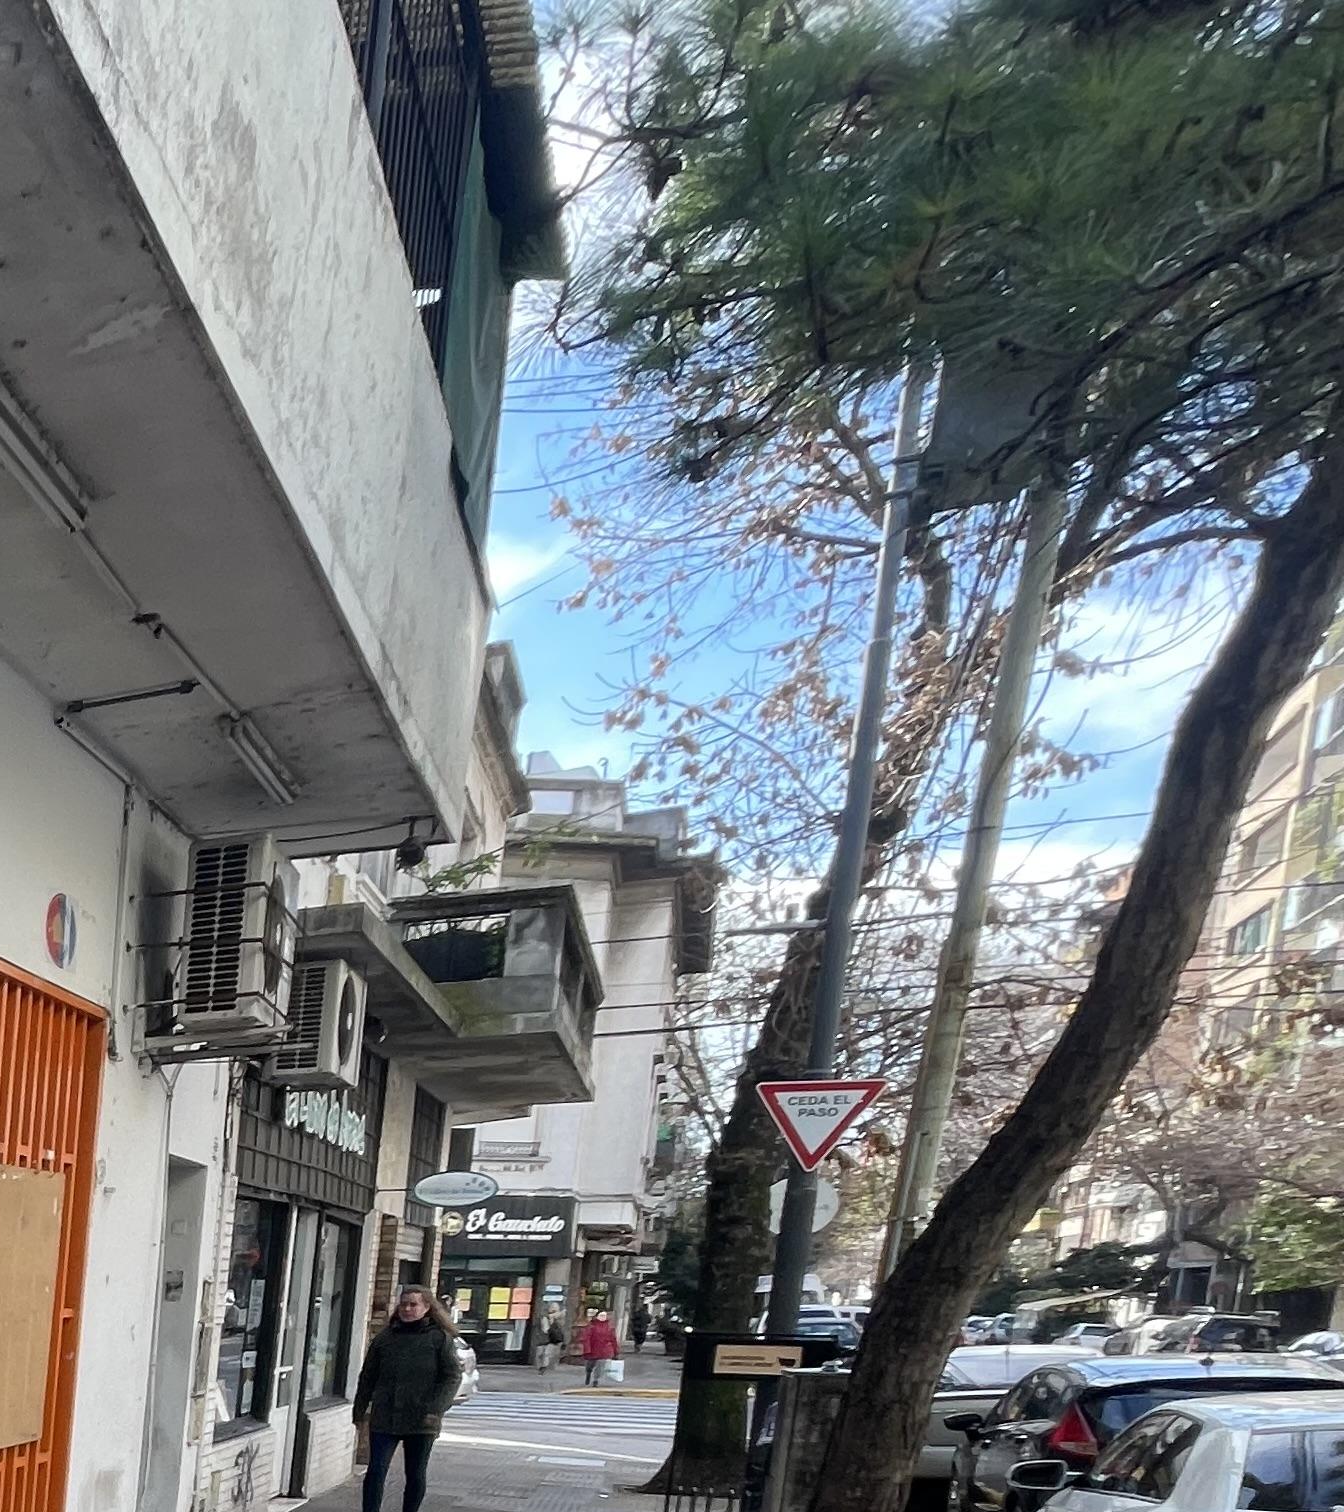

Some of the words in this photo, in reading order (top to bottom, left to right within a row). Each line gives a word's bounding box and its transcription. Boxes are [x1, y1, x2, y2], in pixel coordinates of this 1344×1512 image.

[787, 1095, 829, 1107] CEDA
[833, 1094, 853, 1106] EL
[797, 1106, 839, 1118] PASO
